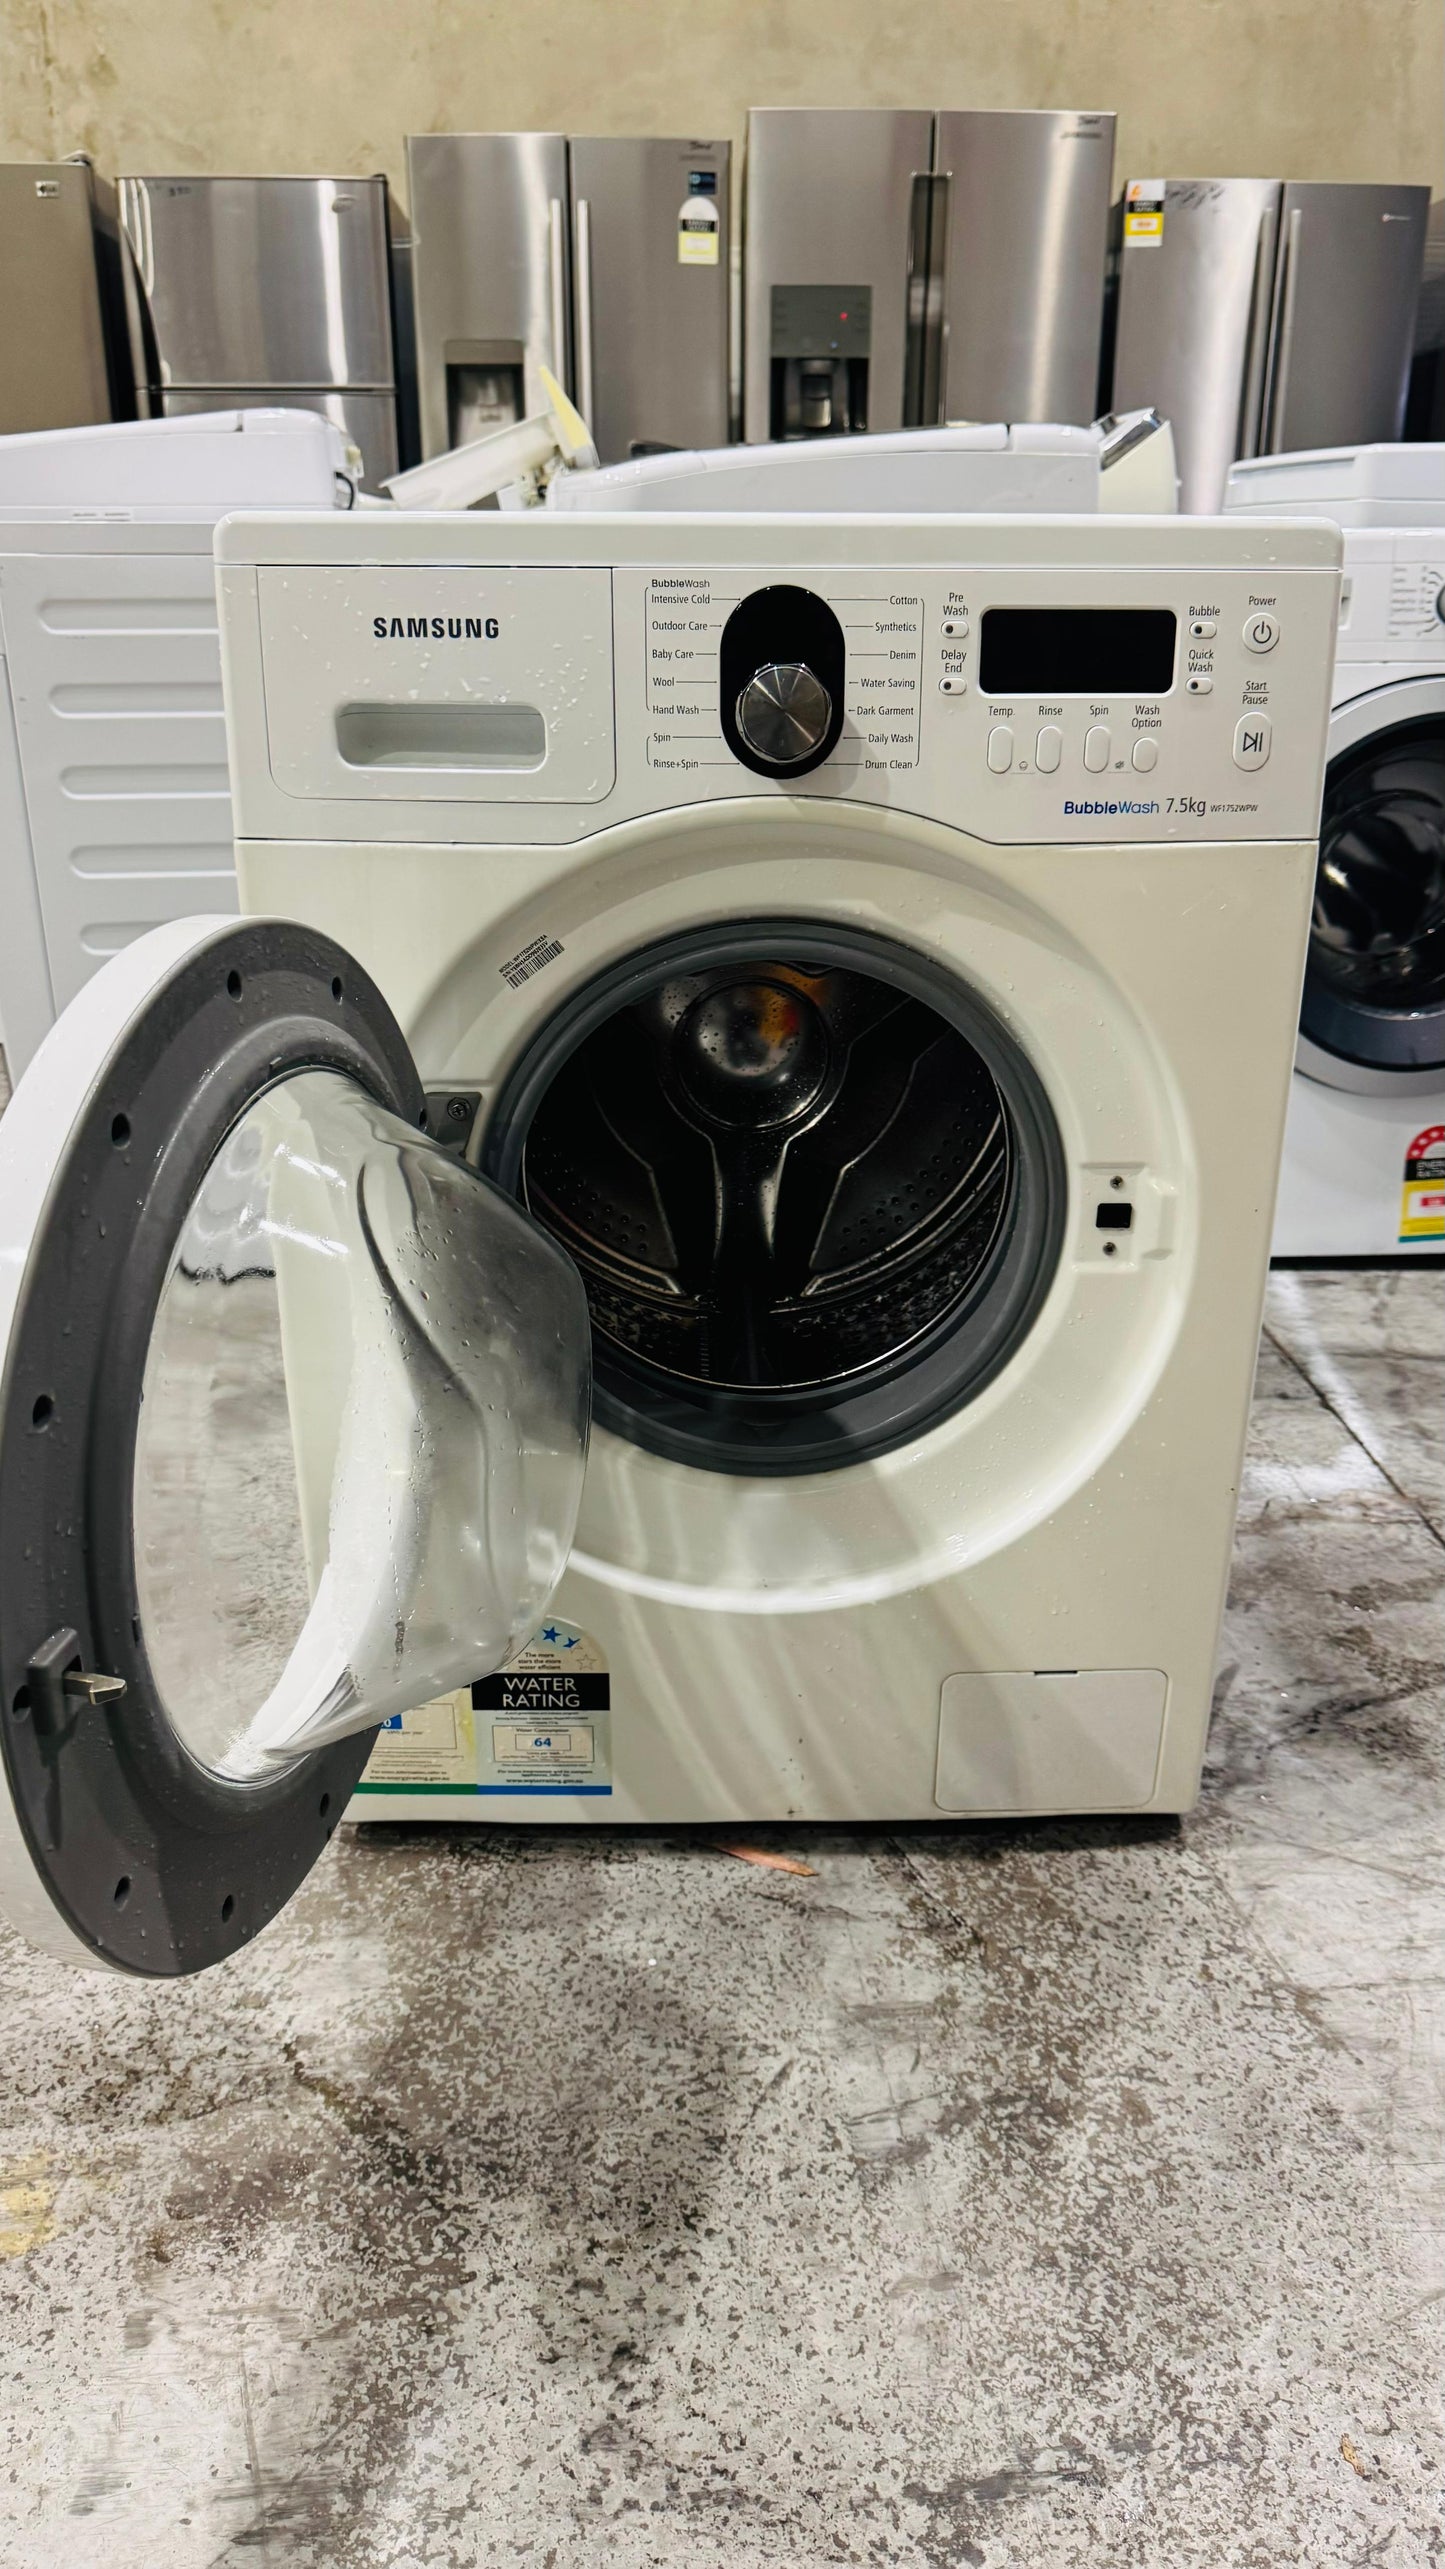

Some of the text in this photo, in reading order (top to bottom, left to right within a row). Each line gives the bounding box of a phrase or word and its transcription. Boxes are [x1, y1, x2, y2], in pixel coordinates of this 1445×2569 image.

[651, 579, 710, 588] BubbleWash
[651, 594, 710, 604] Intensive Cold
[890, 595, 918, 605] Cotton
[949, 592, 964, 603] Pre
[1248, 595, 1277, 606] Power
[943, 605, 968, 616] Wash
[1189, 605, 1220, 616] Bubble
[373, 617, 499, 639] SAMSUNG
[652, 620, 708, 631] Outdoor Care
[875, 622, 917, 634] Synthetics
[652, 649, 694, 661] Baby Care
[890, 650, 916, 660] Denim
[941, 649, 966, 662] Delay
[1188, 649, 1213, 660] Quick
[945, 662, 963, 673] End
[1188, 661, 1213, 672] Wash
[652, 677, 674, 686] Wool
[861, 678, 915, 690] Water Saving
[1246, 680, 1267, 691] Start
[1242, 694, 1268, 705] Pause
[653, 705, 699, 715] Hand Wash
[857, 706, 914, 715] Dark Garment
[988, 705, 1015, 718] Temp.
[1038, 705, 1063, 716] Rinse
[1089, 705, 1109, 717] Spin
[1135, 705, 1160, 715] Wash
[1131, 717, 1162, 730] Option
[653, 732, 671, 744] Spin
[868, 733, 913, 745] Daily Wash
[653, 759, 699, 770] Rinse+Spin
[865, 760, 913, 769] Drum Clean
[1064, 801, 1159, 814] BubbleWash
[1166, 796, 1206, 817] 7.5kg
[504, 1677, 576, 1691] WATER
[503, 1694, 580, 1707] RATING
[534, 1737, 552, 1747] 64
